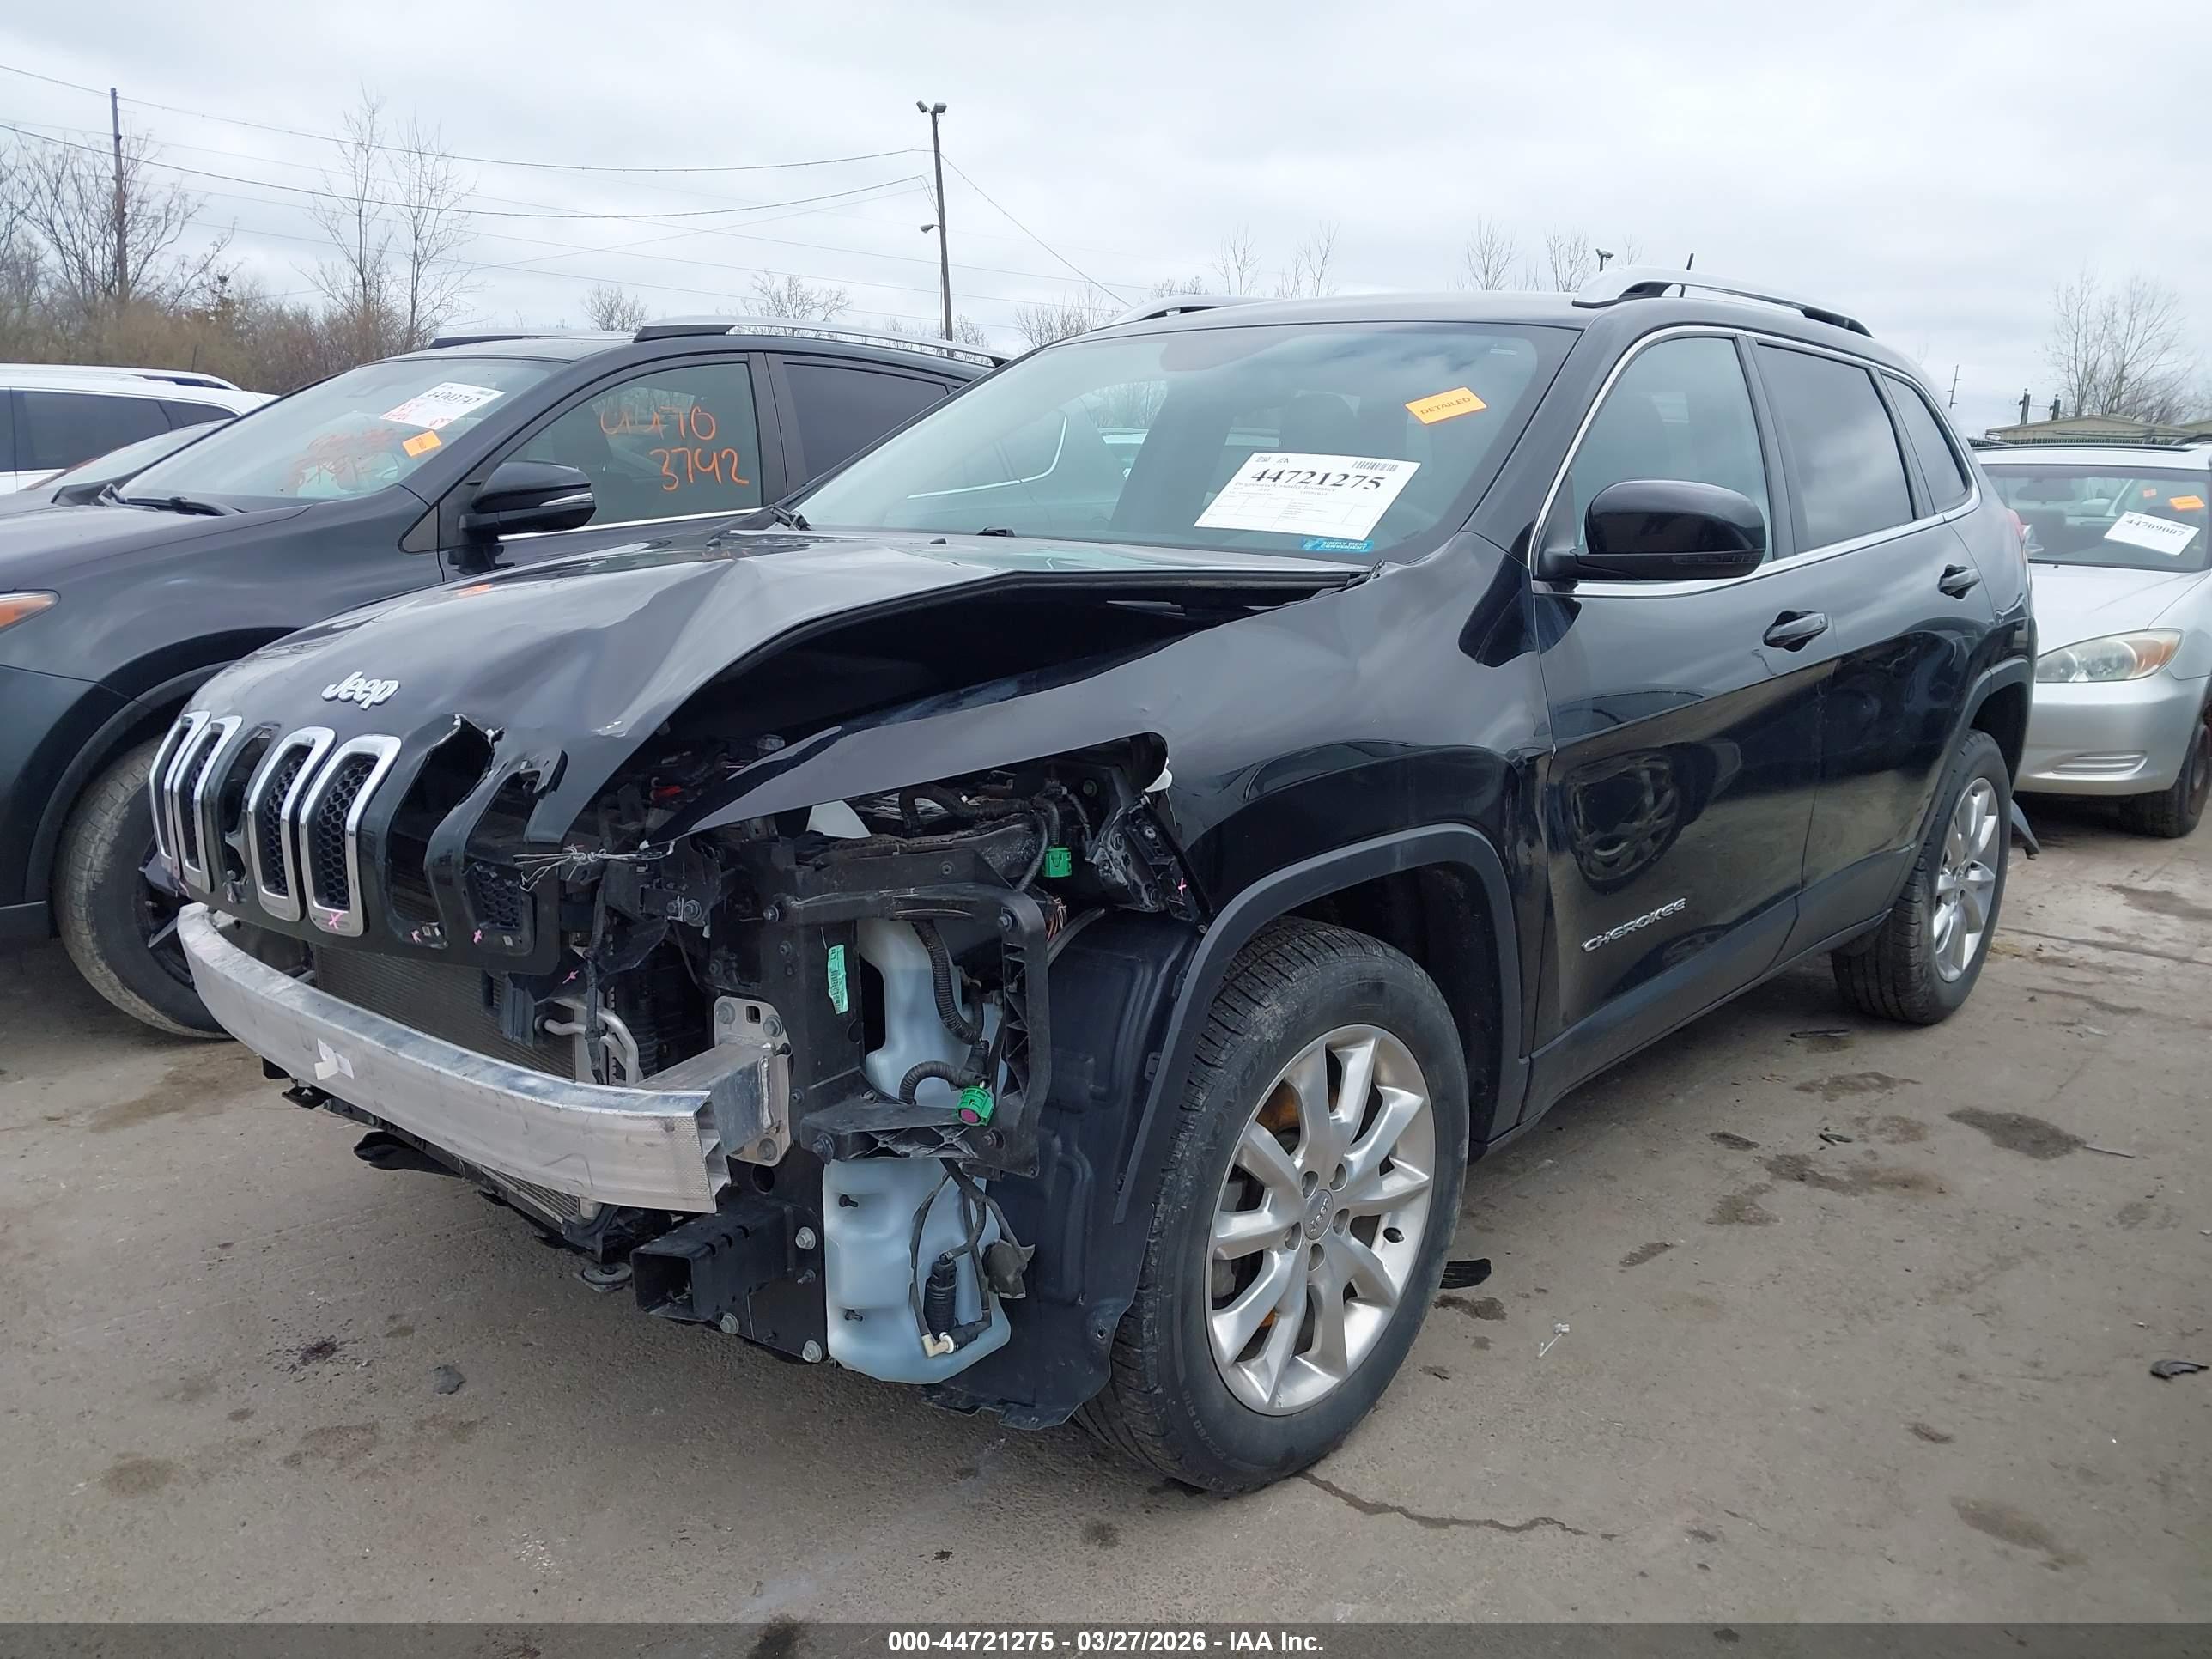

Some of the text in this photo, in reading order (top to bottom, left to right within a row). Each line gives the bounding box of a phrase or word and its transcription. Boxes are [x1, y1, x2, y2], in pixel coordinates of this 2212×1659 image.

[1420, 396, 1471, 415] DETAILED
[649, 447, 750, 491] 3742
[1250, 468, 1387, 490] 44721275
[321, 672, 400, 710] Jeep
[1582, 897, 1686, 952] CHEROKEE
